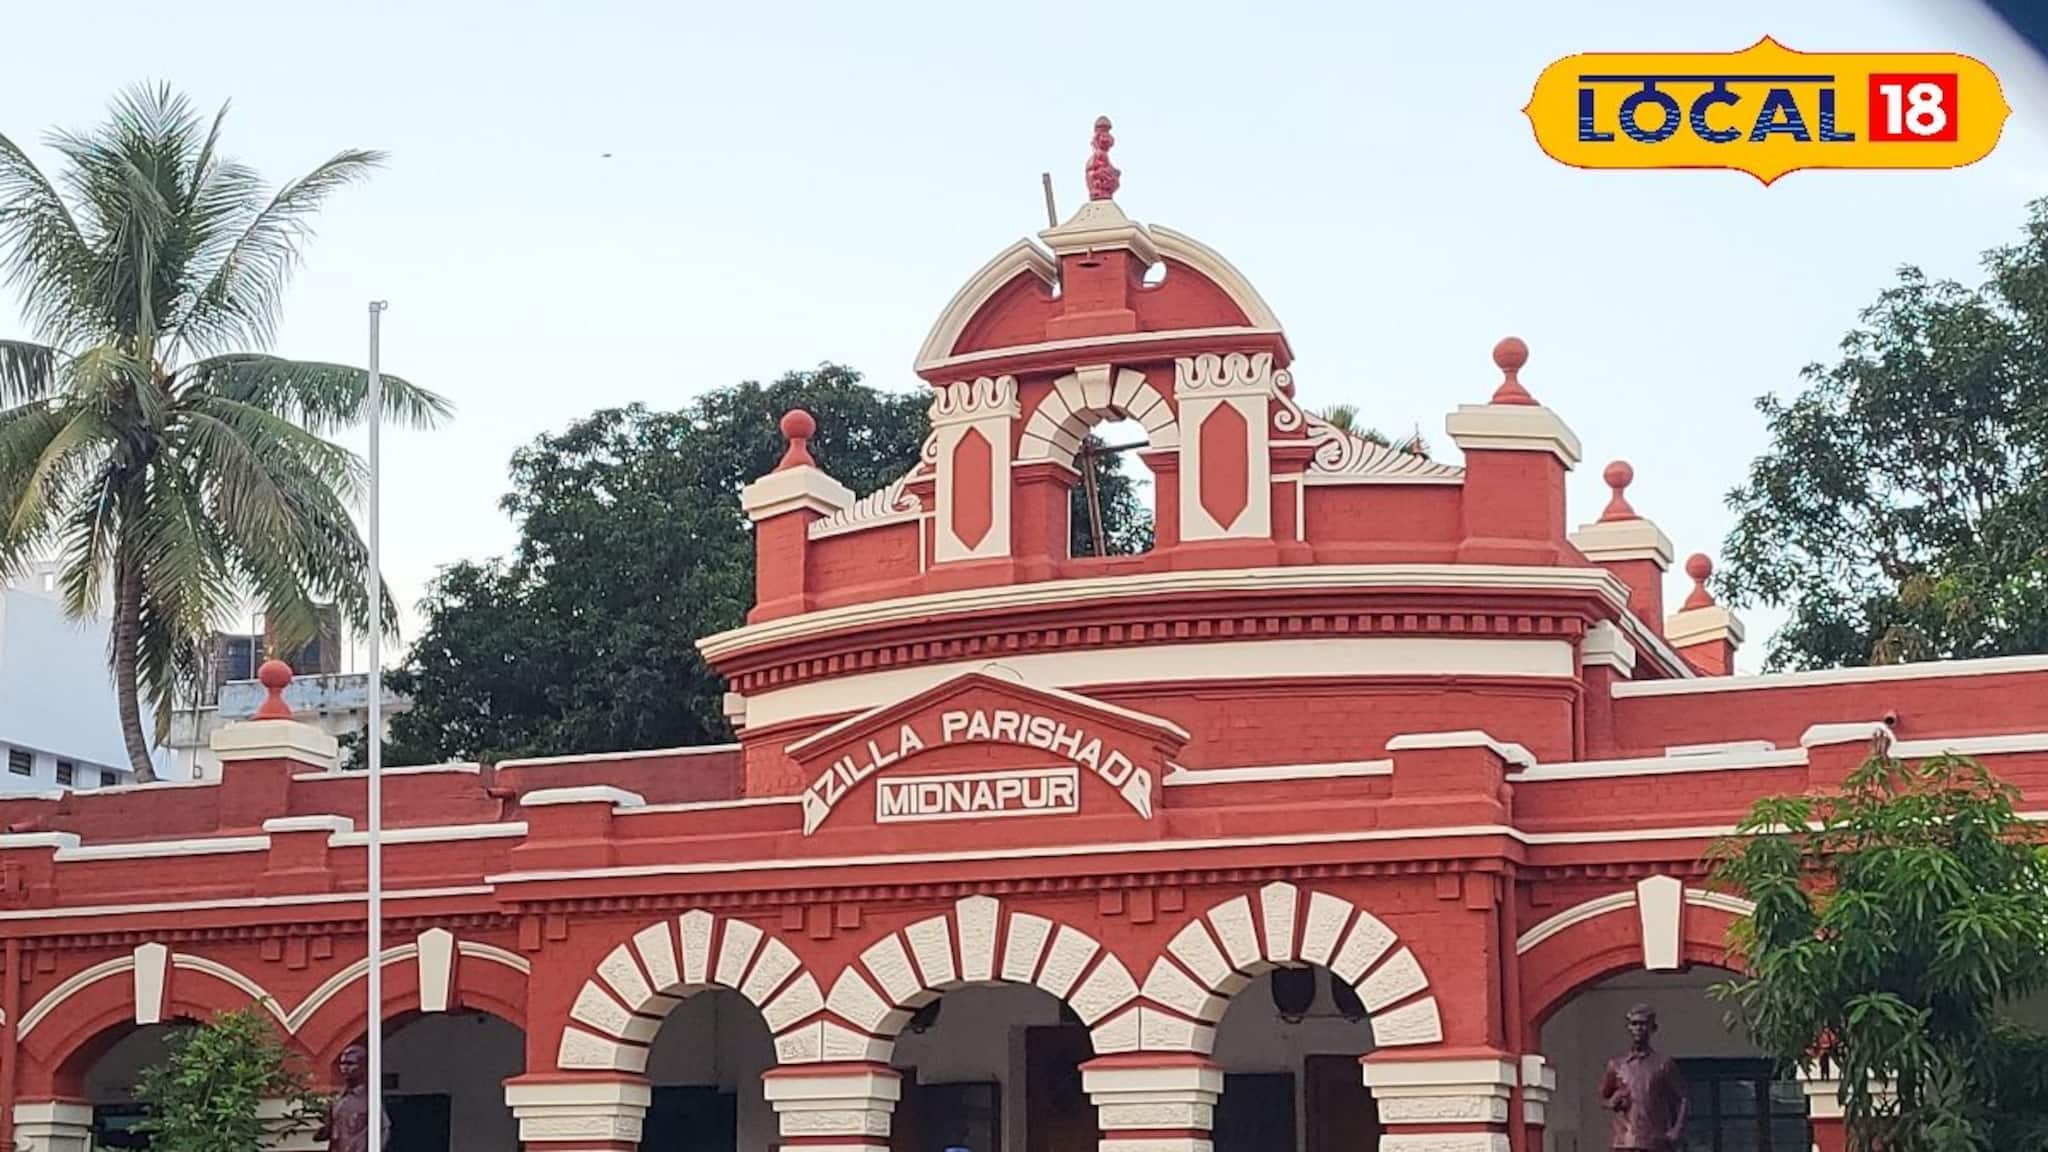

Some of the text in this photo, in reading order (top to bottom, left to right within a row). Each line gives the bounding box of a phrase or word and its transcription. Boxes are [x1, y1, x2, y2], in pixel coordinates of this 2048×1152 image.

[812, 709, 1134, 807] ZILLA PARISHAD
[881, 776, 1074, 816] MIDNAPUR
